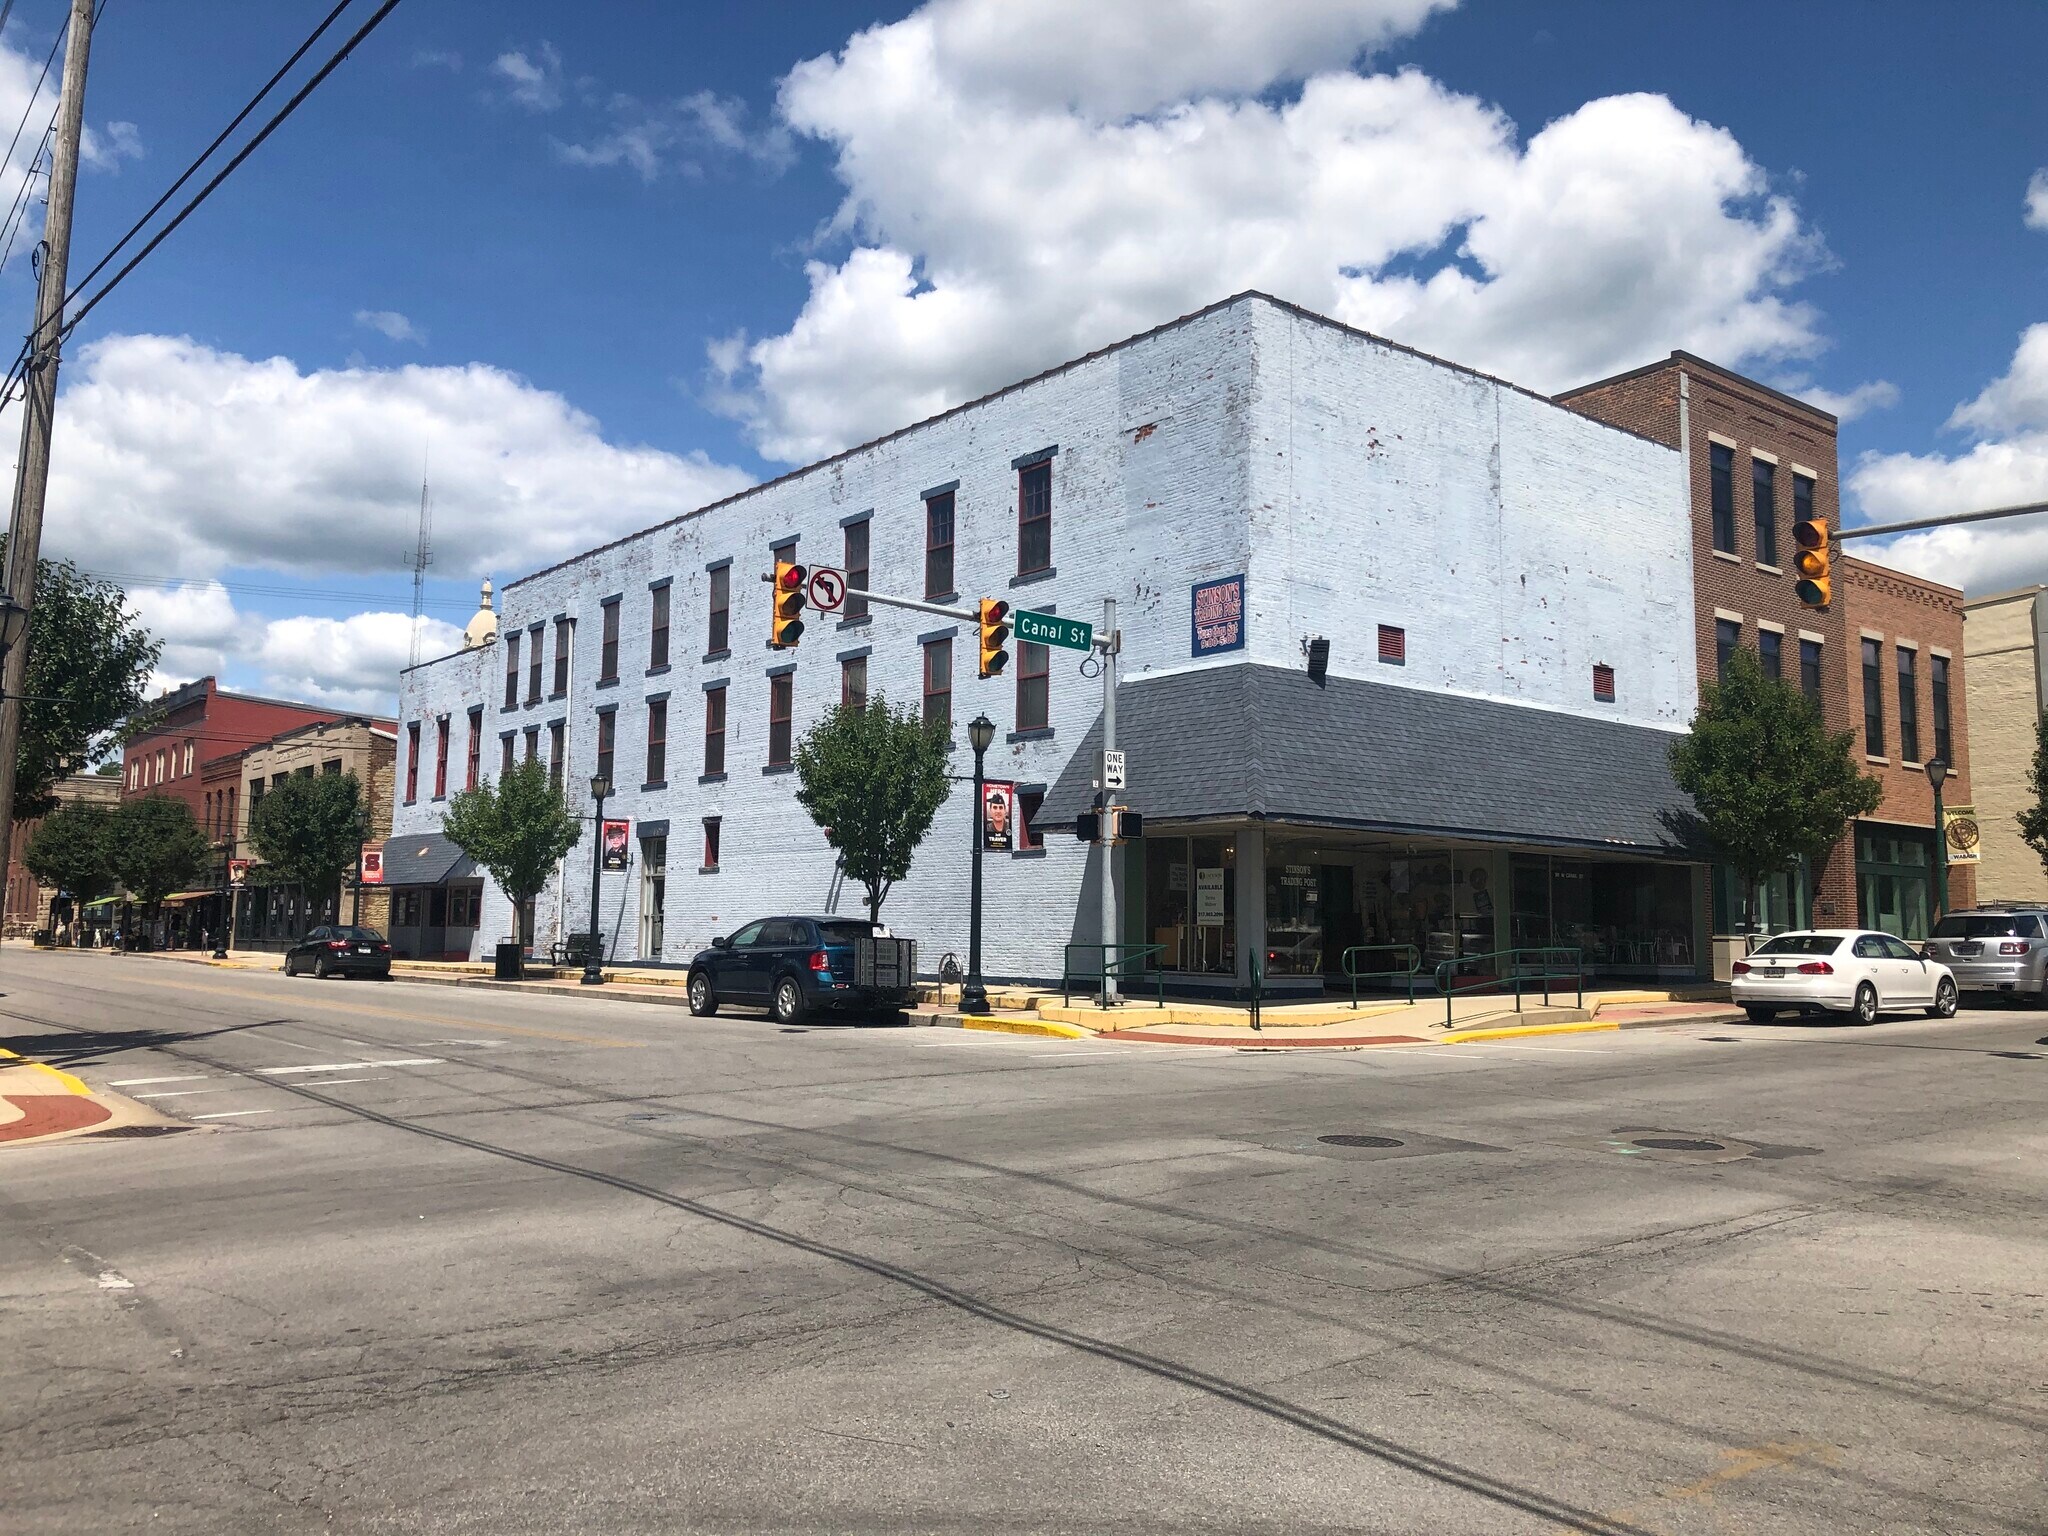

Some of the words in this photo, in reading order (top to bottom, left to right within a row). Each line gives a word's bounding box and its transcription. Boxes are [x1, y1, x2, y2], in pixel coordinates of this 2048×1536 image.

[1196, 582, 1239, 606] STINSON'S
[1194, 604, 1222, 622] TRADING
[1224, 600, 1241, 617] POST
[1021, 618, 1062, 640] Canal
[1070, 627, 1085, 644] St
[1227, 621, 1238, 635] Sat
[1107, 753, 1123, 763] ONE
[1107, 764, 1123, 773] WAY
[1285, 865, 1311, 874] STINSON'S
[1281, 877, 1302, 886] TRADING
[1303, 878, 1318, 887] POST
